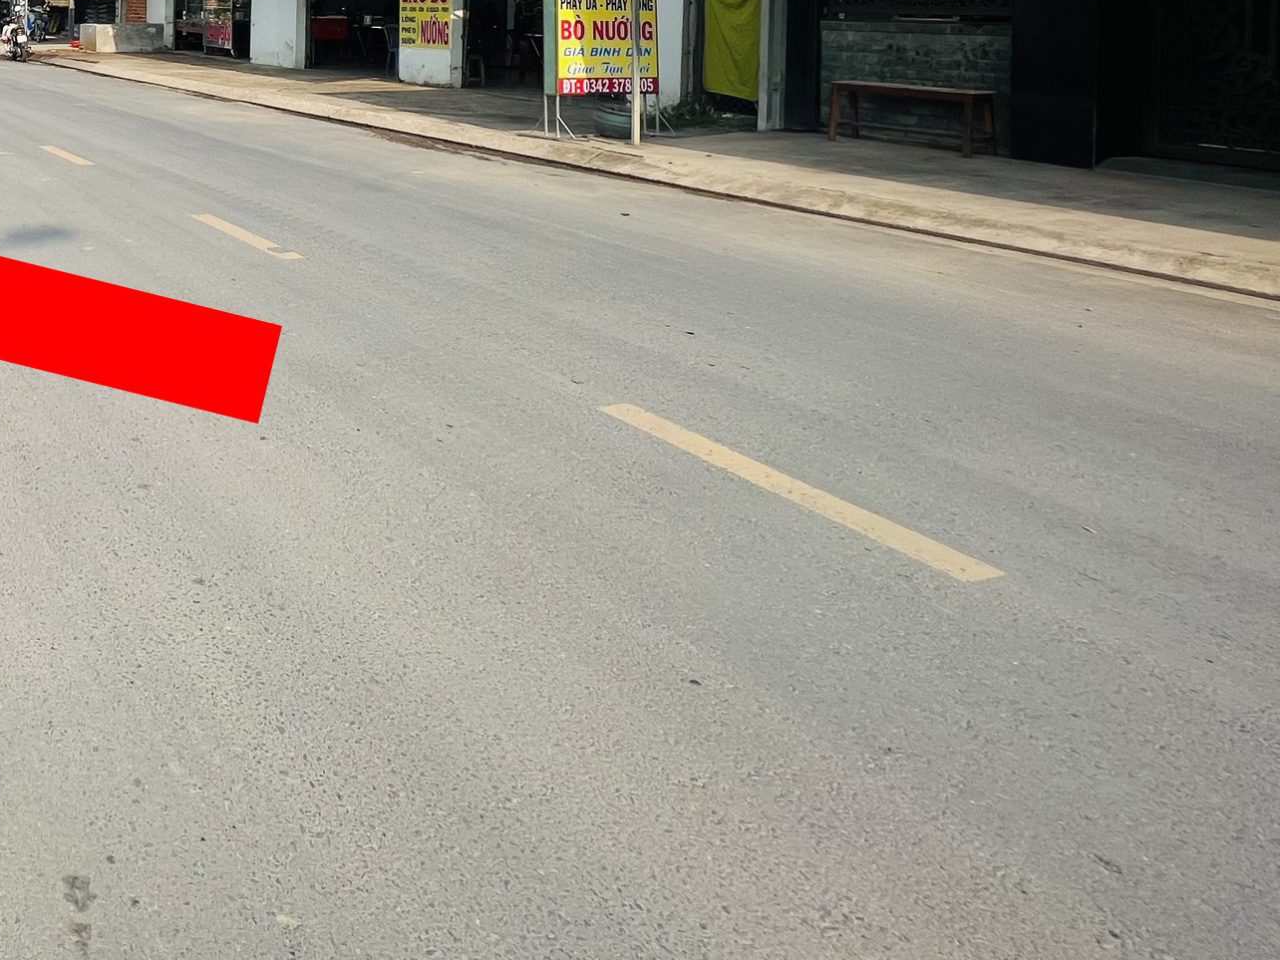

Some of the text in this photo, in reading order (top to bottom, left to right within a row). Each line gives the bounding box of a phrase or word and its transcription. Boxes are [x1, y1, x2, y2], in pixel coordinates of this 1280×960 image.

[420, 13, 449, 46] NƯỚNG
[561, 14, 585, 41] BÒ
[564, 45, 585, 57] GIÁ
[590, 45, 620, 57] BÌNH
[563, 79, 580, 94] ĐT:
[583, 78, 609, 93] 0342
[613, 78, 632, 92] 378
